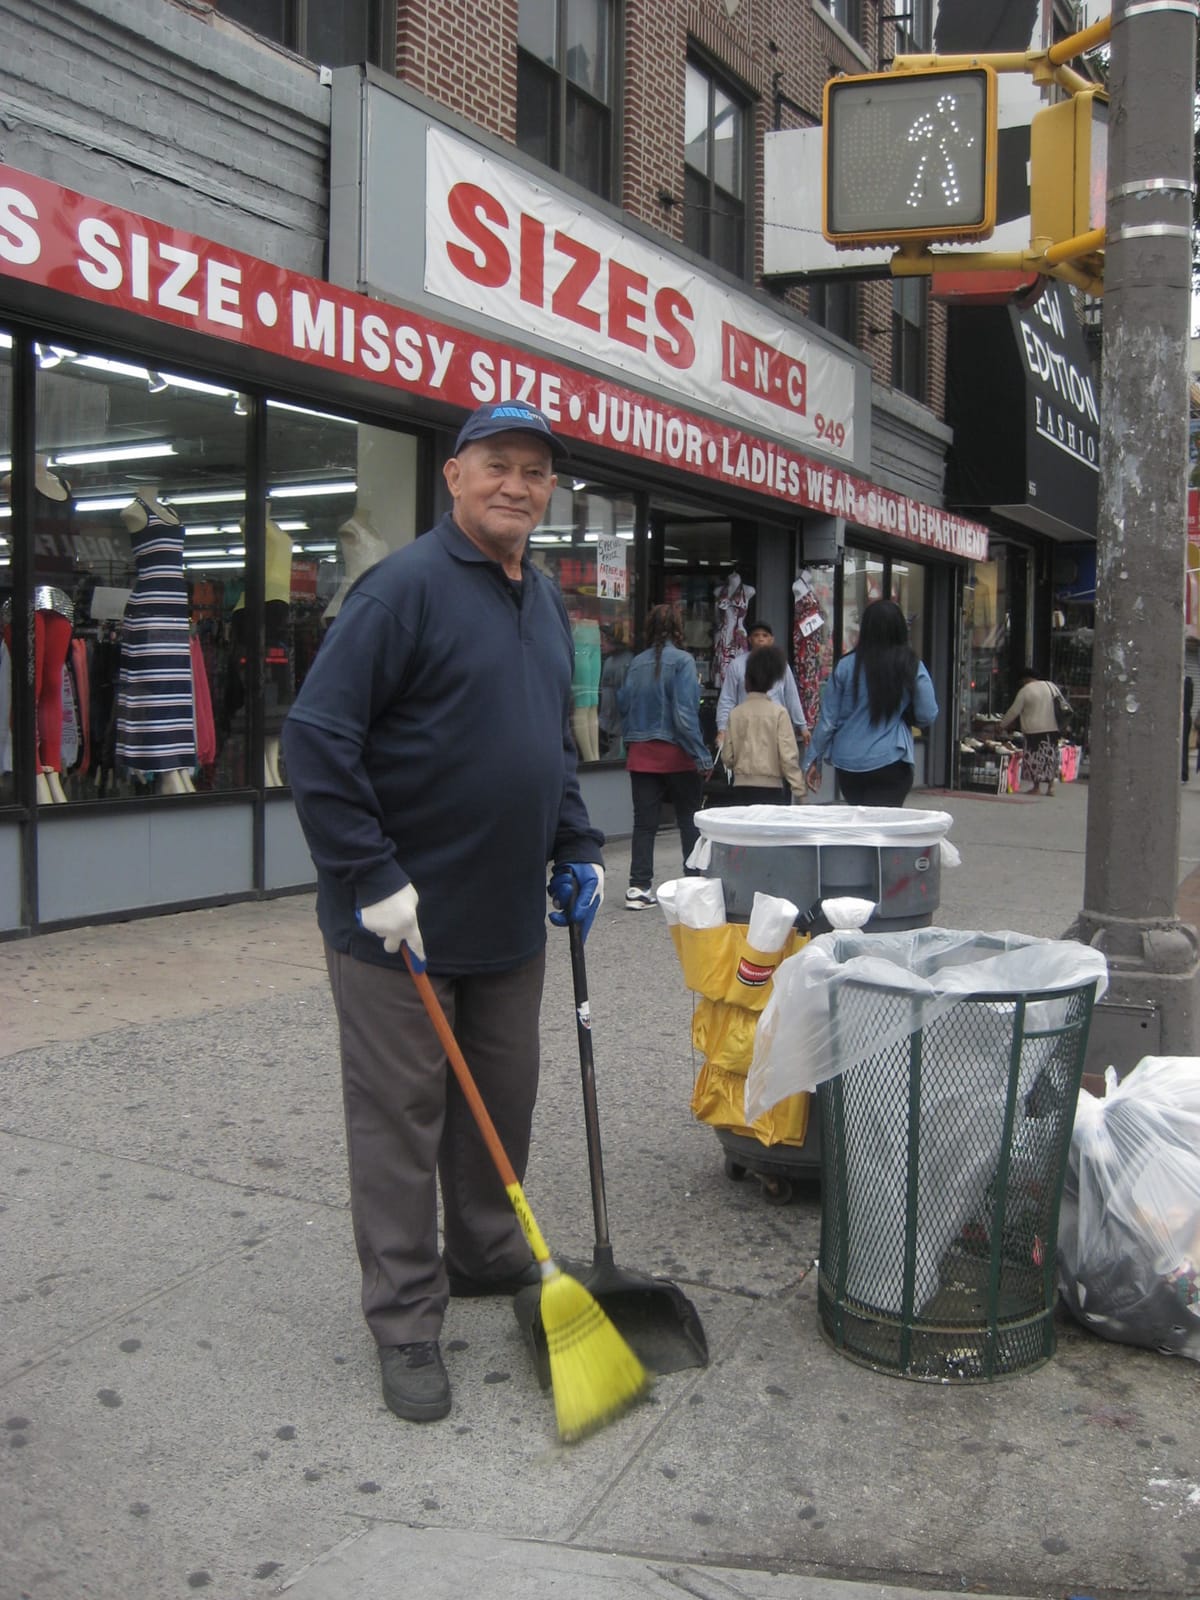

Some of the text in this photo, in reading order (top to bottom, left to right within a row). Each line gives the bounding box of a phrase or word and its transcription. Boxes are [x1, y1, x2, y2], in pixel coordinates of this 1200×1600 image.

[446, 181, 695, 370] SIZES
[1033, 290, 1065, 339] EW
[77, 217, 244, 329] SIZE
[470, 352, 562, 422] SIZE
[588, 391, 703, 466] JUNIOR
[722, 436, 800, 496] LADIES
[807, 467, 856, 515] WEAR
[867, 491, 906, 531] SHOE
[910, 501, 987, 557] DEPARTMENT
[729, 334, 802, 408] I-N-C
[1020, 320, 1099, 425] EDITION
[814, 412, 846, 448] 949
[1035, 396, 1098, 462] FASHIO
